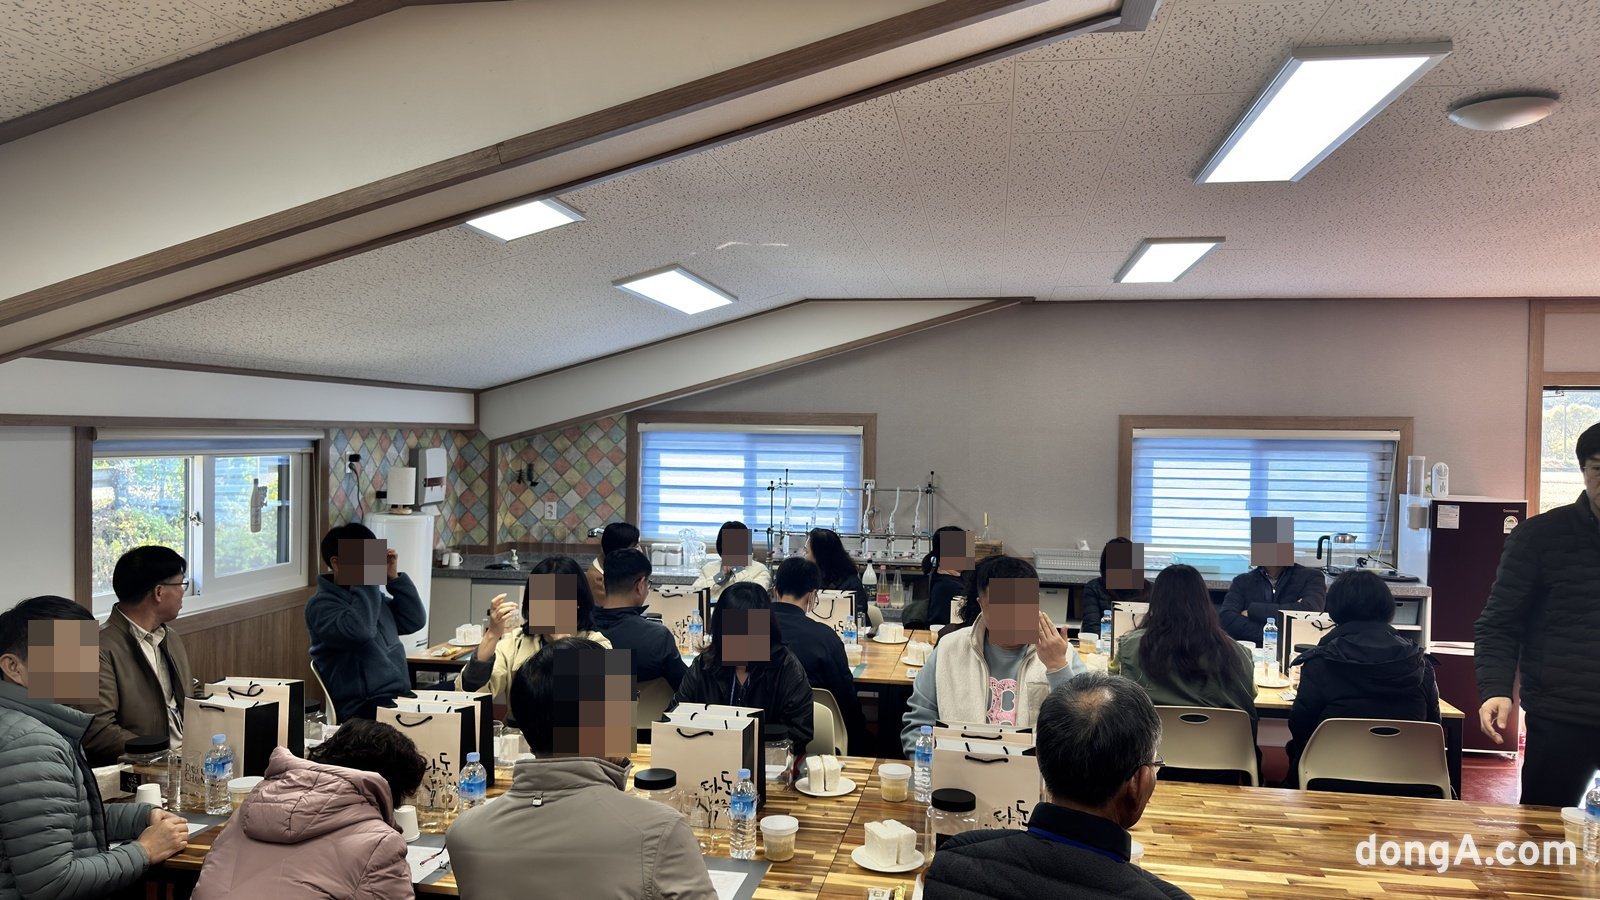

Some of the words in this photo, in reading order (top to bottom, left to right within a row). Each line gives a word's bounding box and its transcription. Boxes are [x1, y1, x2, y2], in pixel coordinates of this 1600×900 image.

[700, 770, 733, 796] 다도
[694, 792, 732, 829] 참주
[993, 800, 1030, 827] 다도
